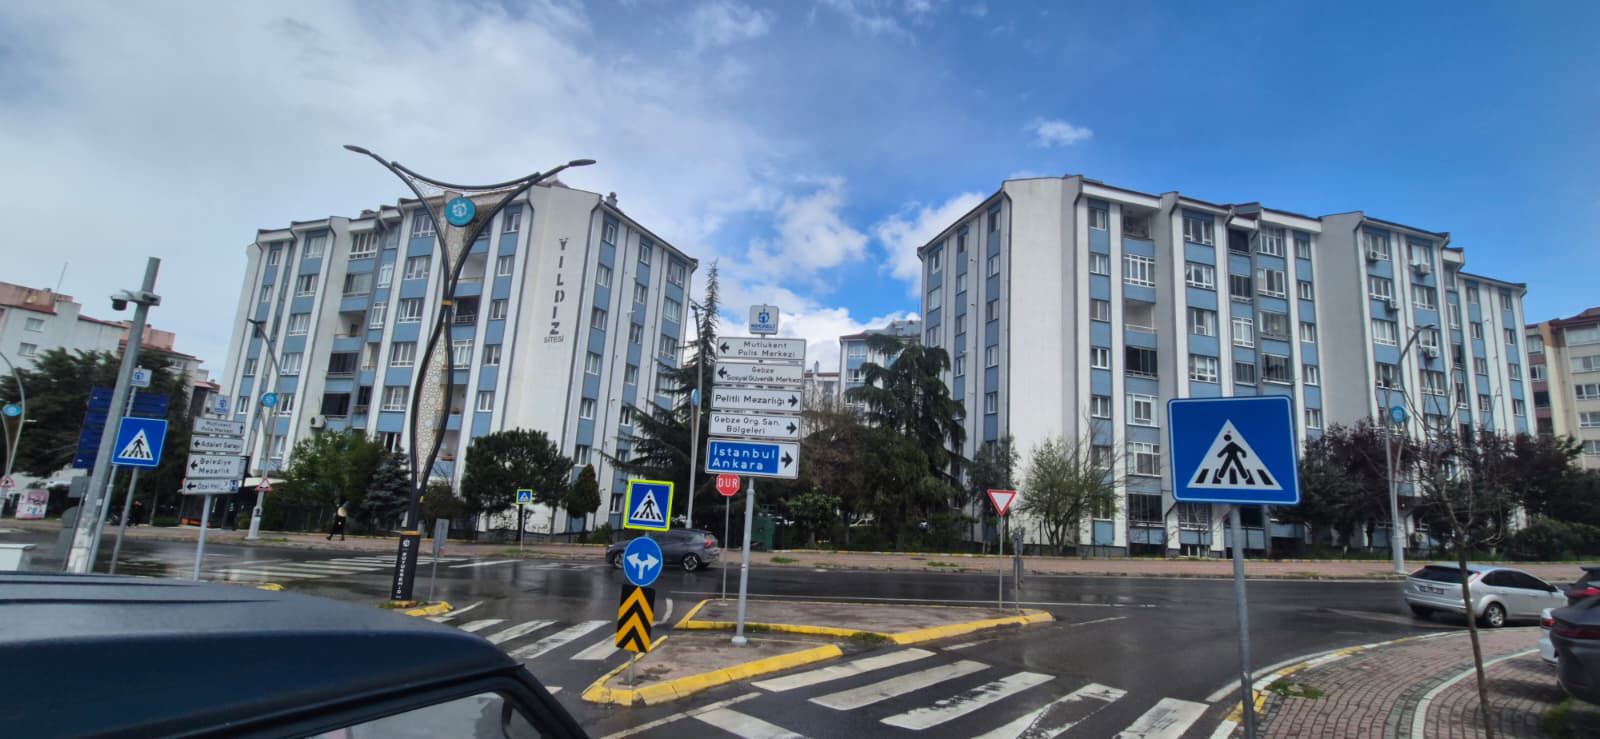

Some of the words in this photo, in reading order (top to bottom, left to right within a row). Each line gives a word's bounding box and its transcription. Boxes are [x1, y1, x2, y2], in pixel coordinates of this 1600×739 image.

[549, 238, 568, 335] YILDIZ
[743, 341, 787, 349] Mutlukent
[762, 350, 796, 358] Merkezi
[752, 366, 774, 374] Gebze
[715, 394, 740, 403] Pelitli
[743, 395, 785, 405] Mezarlığı
[714, 415, 740, 423] Gebze
[726, 425, 766, 434] Bölgeleri
[713, 443, 775, 459] İstanbul
[200, 457, 232, 466] Belediye
[712, 457, 764, 471] Ankara
[719, 478, 738, 488] DUR
